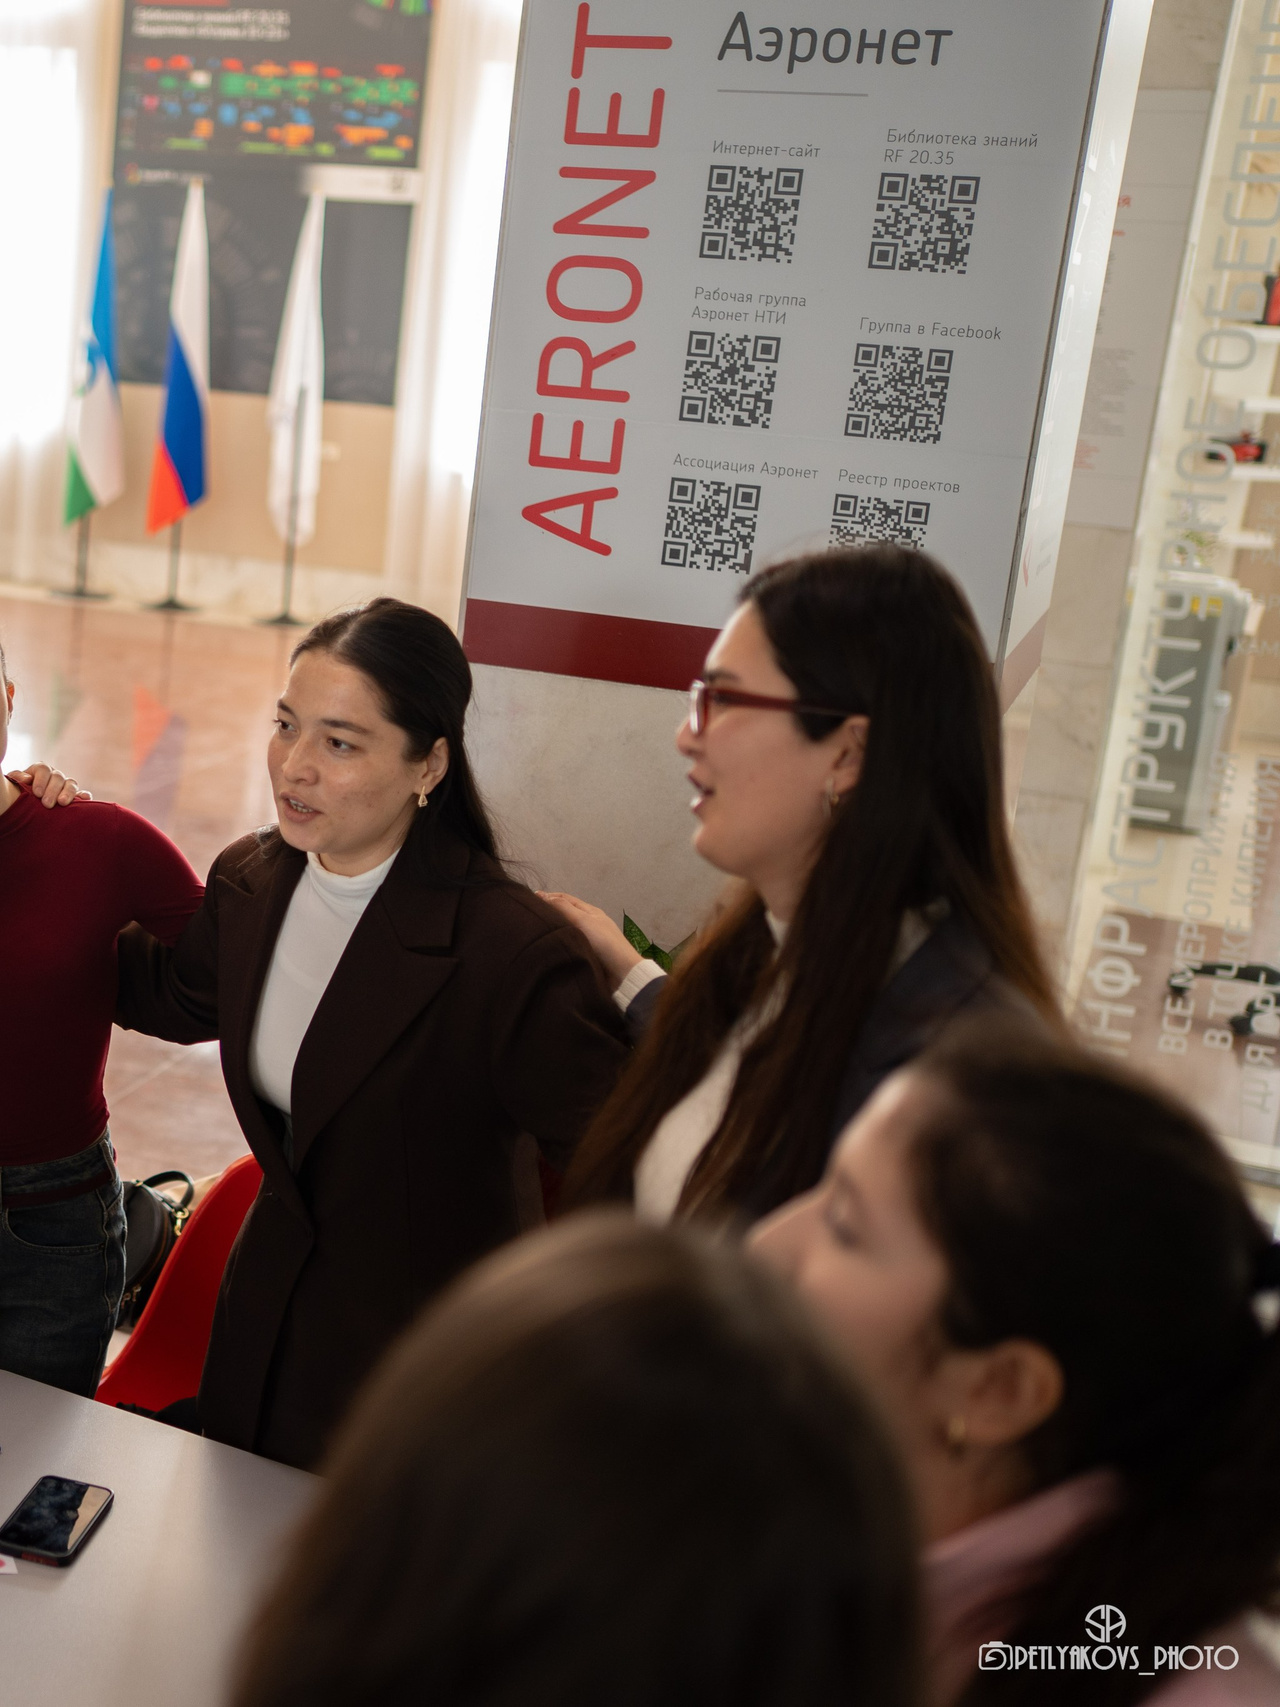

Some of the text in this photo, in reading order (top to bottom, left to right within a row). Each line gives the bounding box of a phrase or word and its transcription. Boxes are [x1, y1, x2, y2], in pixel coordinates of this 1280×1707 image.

[717, 10, 954, 75] Аэронет
[712, 140, 821, 158] Интернет-сайт
[885, 128, 1038, 148] Библиотека знаний
[883, 148, 954, 165] RF 20.35
[521, 2, 673, 556] AERONET
[694, 286, 807, 308] Рабочая группа
[1023, 15, 1116, 588] AERONE
[691, 307, 787, 325] Аэронет НТИ
[859, 316, 1002, 340] Группа в Facebook
[673, 453, 819, 479] Ассоциация Аэронет
[838, 468, 961, 494] Реестр проектов
[1204, 755, 1280, 1052] В ТОЧКЕ КИПЕНИЯ
[1158, 996, 1195, 1056] ВСЕ
